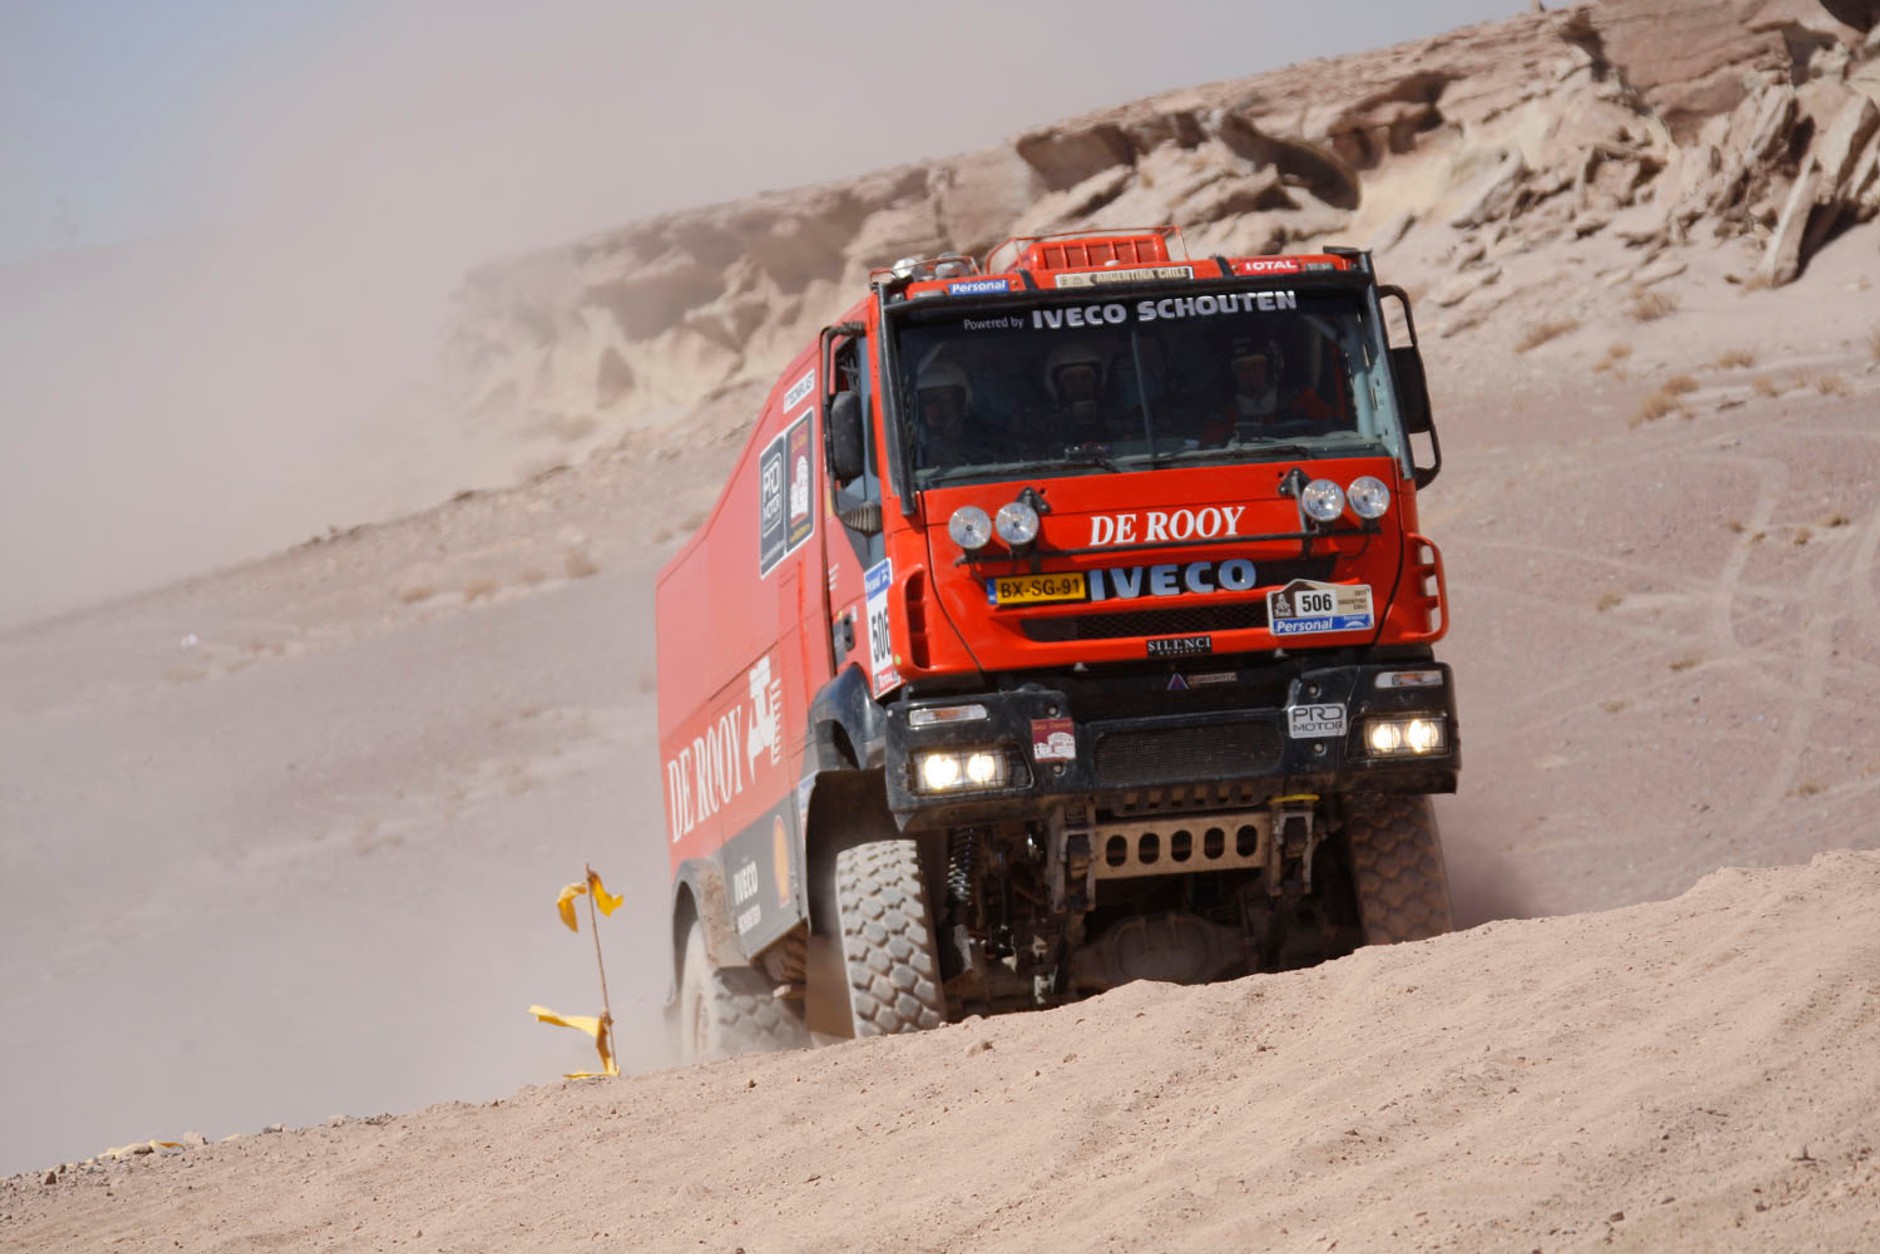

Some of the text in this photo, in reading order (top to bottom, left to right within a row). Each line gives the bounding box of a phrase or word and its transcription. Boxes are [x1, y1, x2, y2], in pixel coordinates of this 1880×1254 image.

[951, 280, 1006, 294] Personal
[963, 290, 1297, 331] Powered by IVECO SCHOUTEN
[1089, 506, 1246, 547] DE ROOY
[1000, 578, 1081, 599] BX-SG-91
[1087, 558, 1257, 601] IVECO
[1301, 593, 1333, 613] 506
[1276, 617, 1334, 633] Personal
[1292, 706, 1343, 723] PRO
[1293, 721, 1344, 733] MOTOR
[667, 704, 743, 844] DE ROOY
